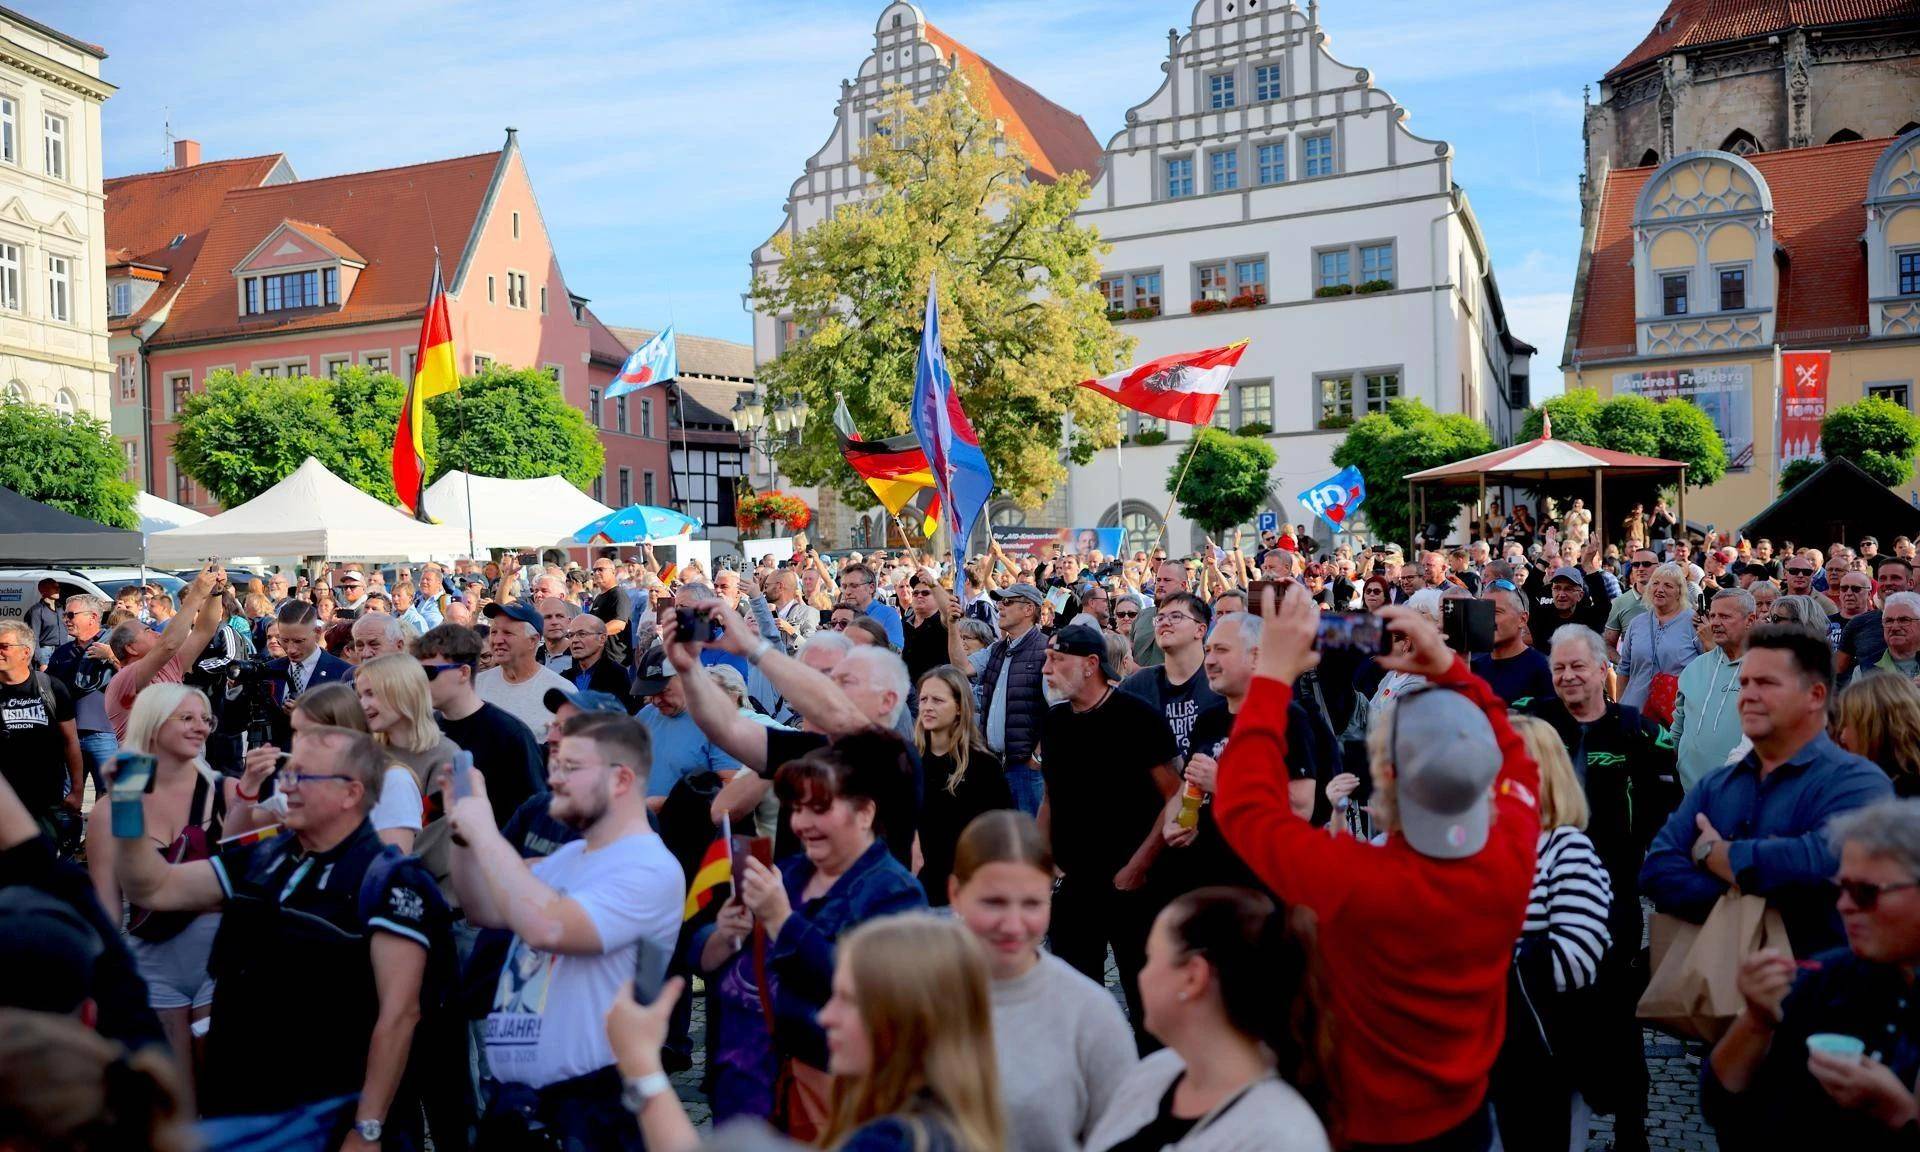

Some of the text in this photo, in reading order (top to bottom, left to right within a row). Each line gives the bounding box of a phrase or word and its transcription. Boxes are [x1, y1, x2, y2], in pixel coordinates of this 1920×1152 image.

[1622, 372, 1744, 389] Andrea Freiberg
[1262, 515, 1273, 529] P
[8, 697, 42, 707] Original
[1165, 699, 1199, 718] ALLES-
[2, 704, 47, 721] NSDALE
[500, 1017, 542, 1038] JAHR!
